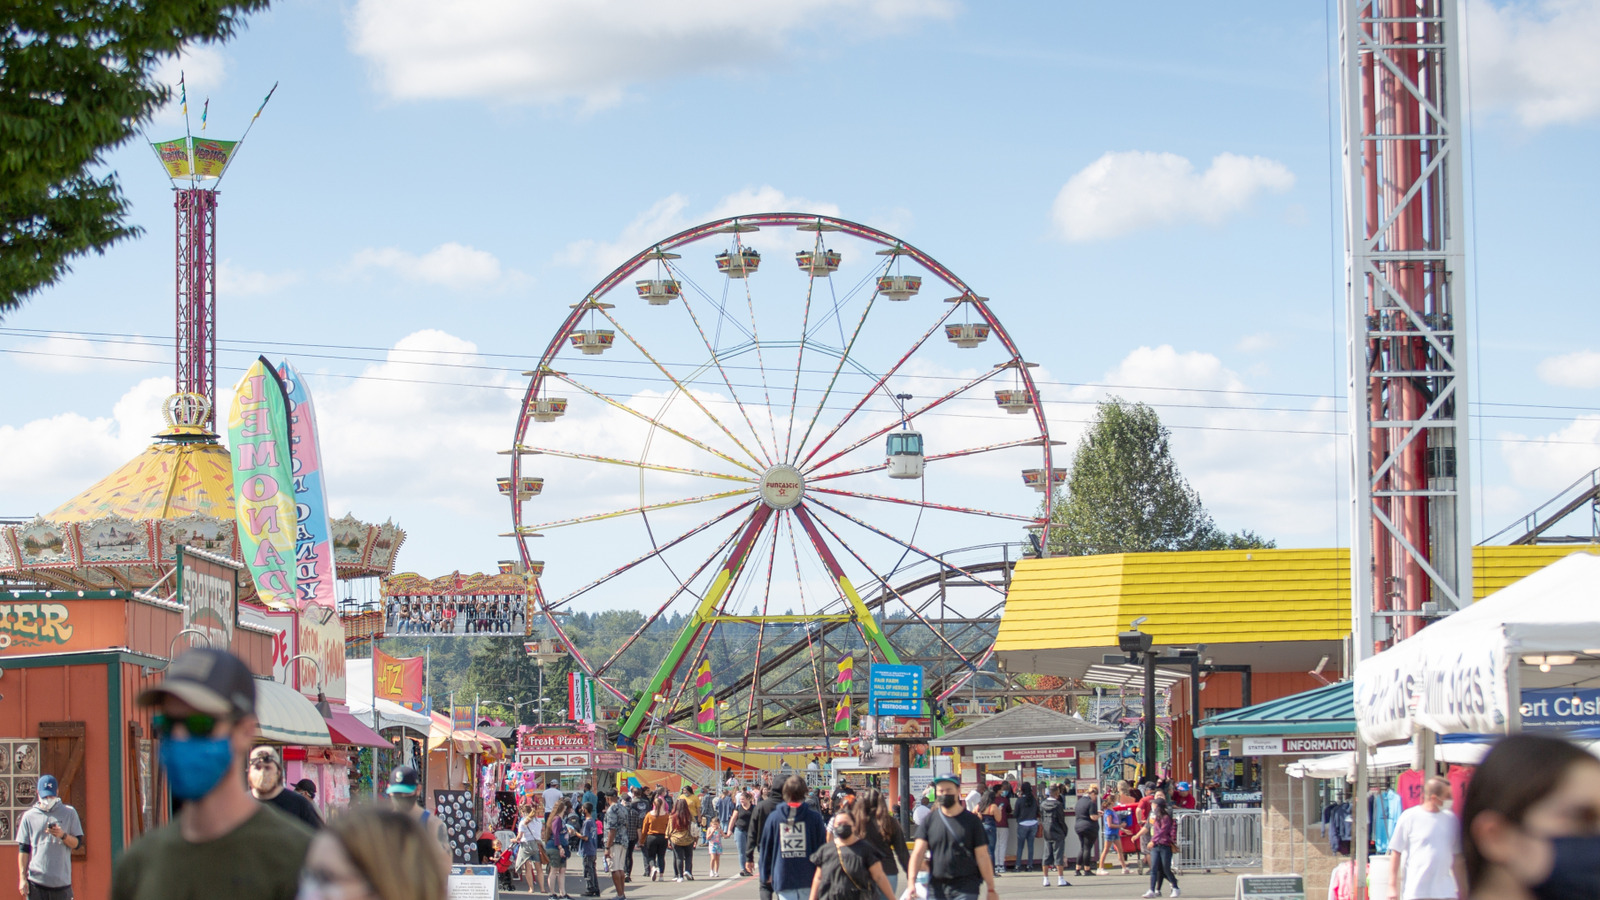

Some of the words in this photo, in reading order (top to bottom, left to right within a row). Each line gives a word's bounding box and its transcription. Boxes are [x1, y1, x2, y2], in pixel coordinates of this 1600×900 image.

[584, 685, 592, 719] PIZZA
[529, 736, 554, 746] Fresh
[557, 734, 584, 745] Pizza
[1287, 739, 1355, 750] INFORMATION
[395, 771, 403, 783] S
[783, 839, 804, 849] KZ
